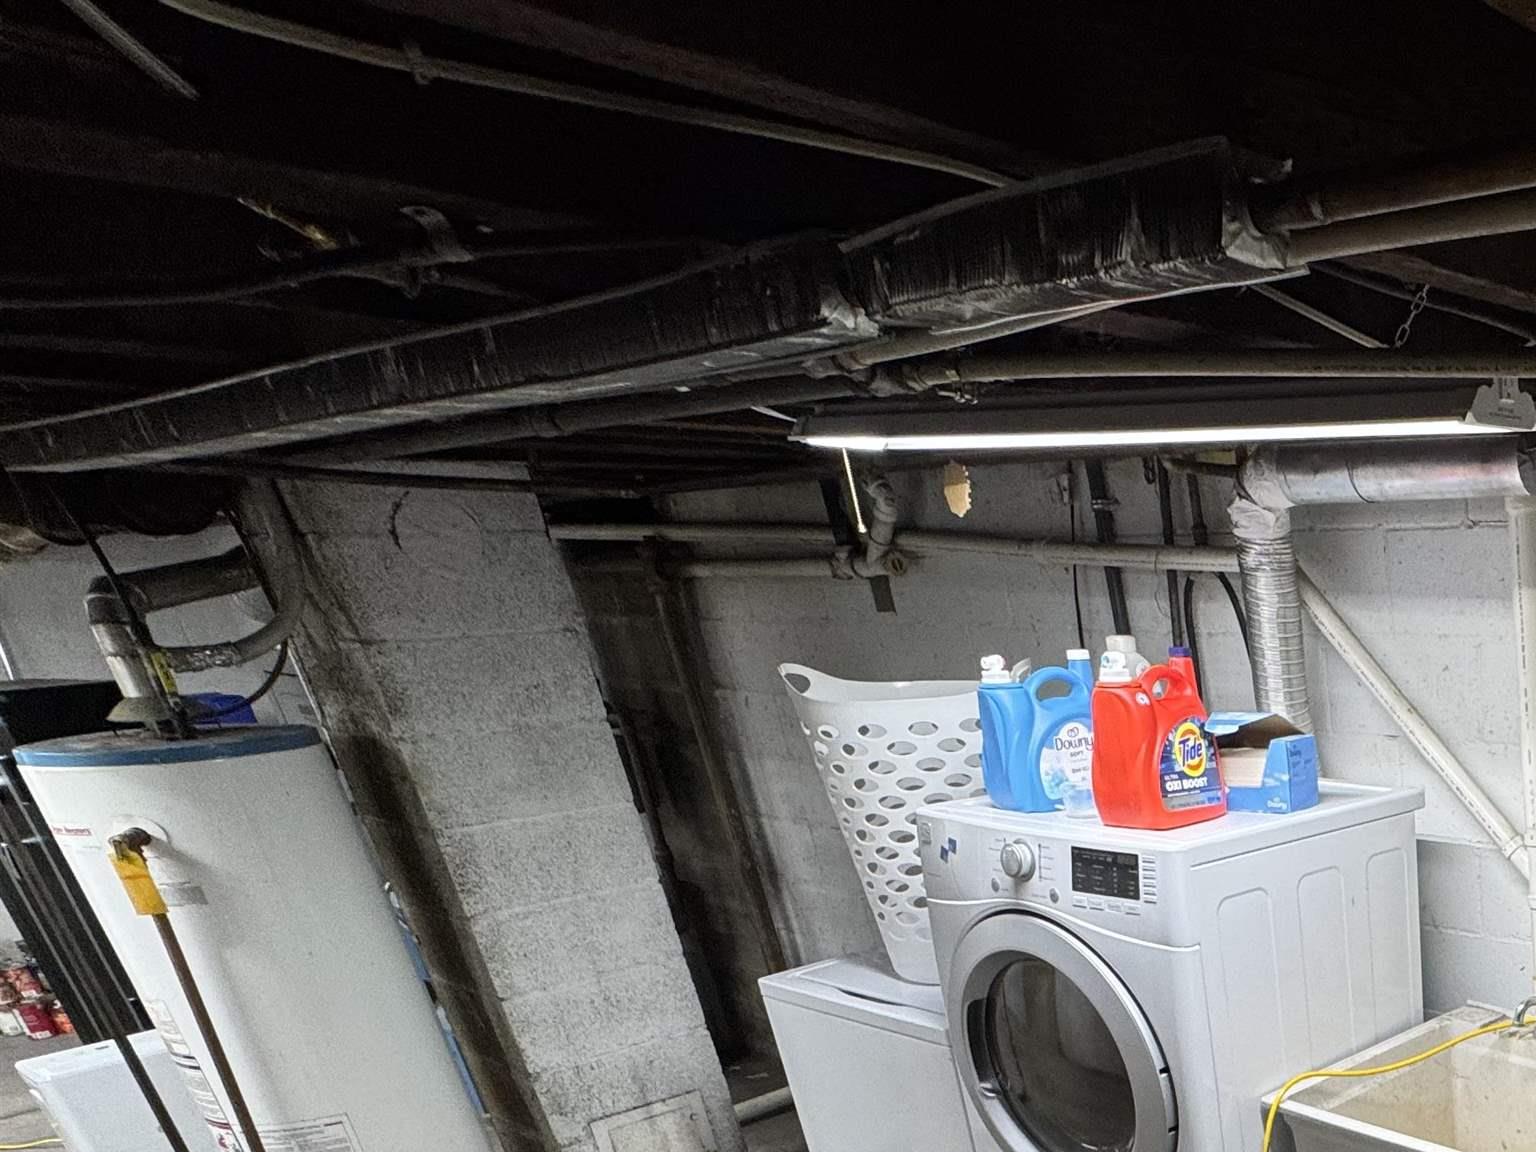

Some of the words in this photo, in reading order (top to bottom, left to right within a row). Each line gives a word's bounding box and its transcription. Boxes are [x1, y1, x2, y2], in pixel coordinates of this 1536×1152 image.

[1054, 736, 1094, 751] Downy
[1179, 738, 1203, 767] Tide
[1165, 781, 1182, 792] OXI
[1182, 776, 1208, 789] BOOST
